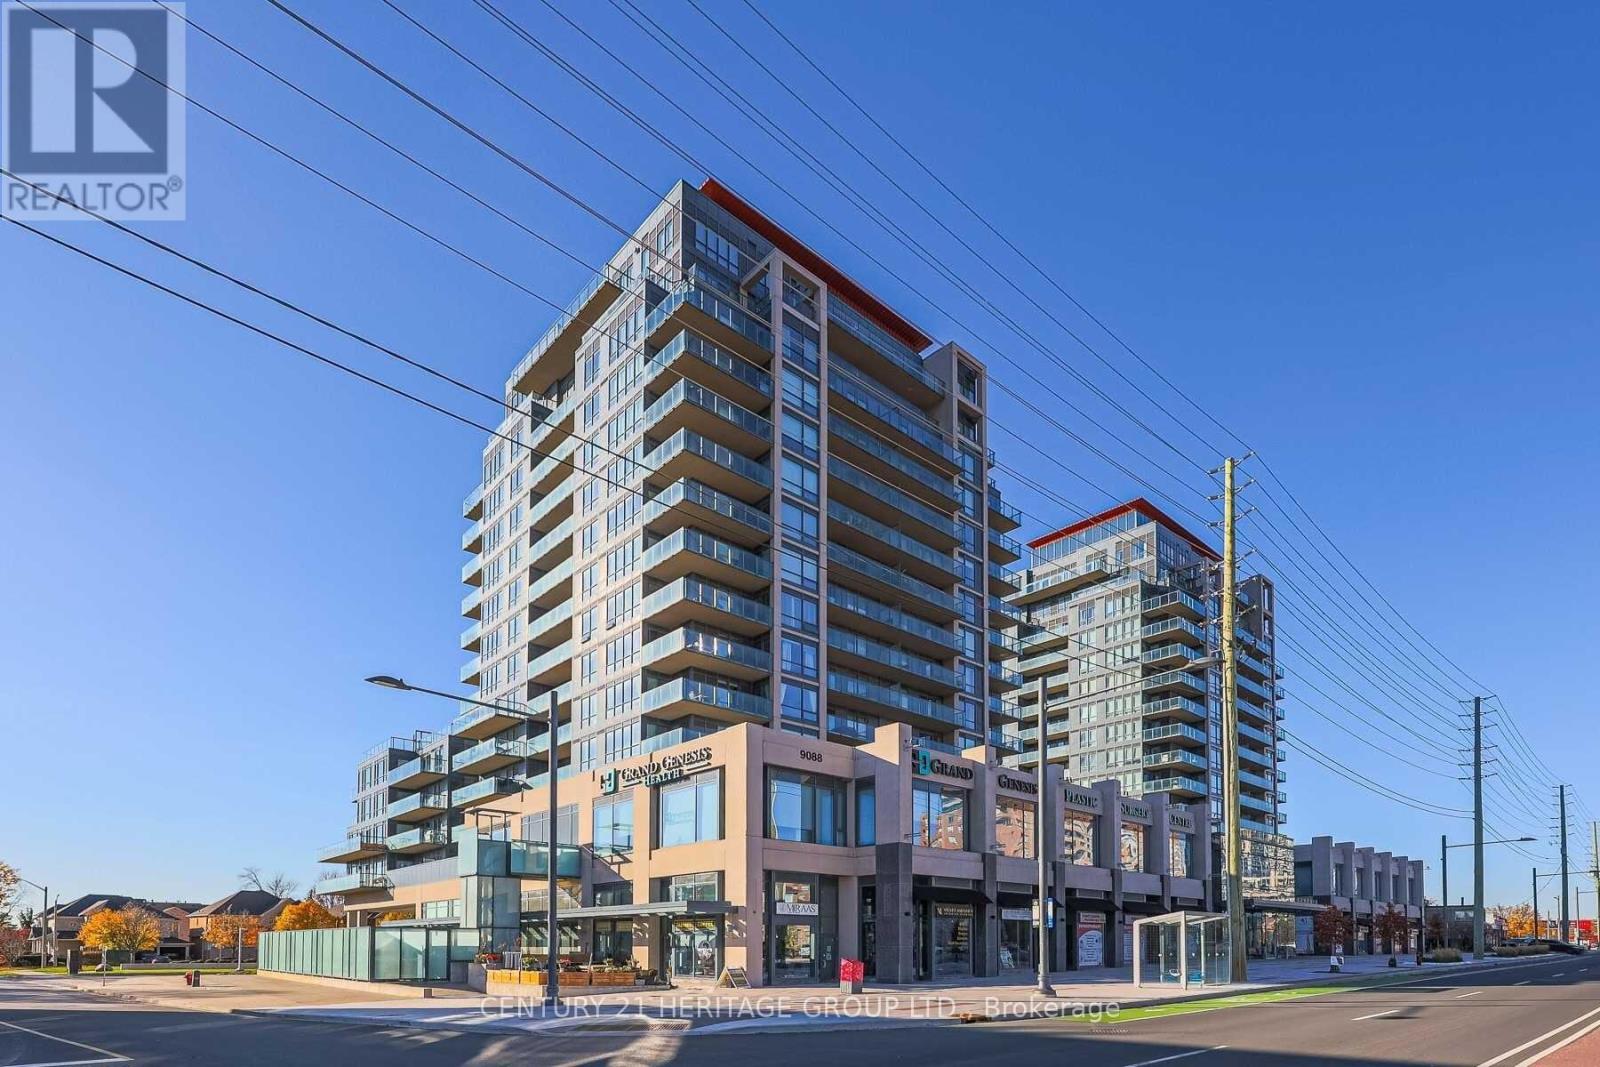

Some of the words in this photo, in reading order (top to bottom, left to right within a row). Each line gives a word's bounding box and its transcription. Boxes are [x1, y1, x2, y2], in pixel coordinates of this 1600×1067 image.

[621, 763, 660, 781] GRAND
[662, 747, 713, 770] GENESIS
[800, 750, 823, 763] 9088
[644, 768, 684, 787] HEALTH
[931, 759, 974, 781] GRAND
